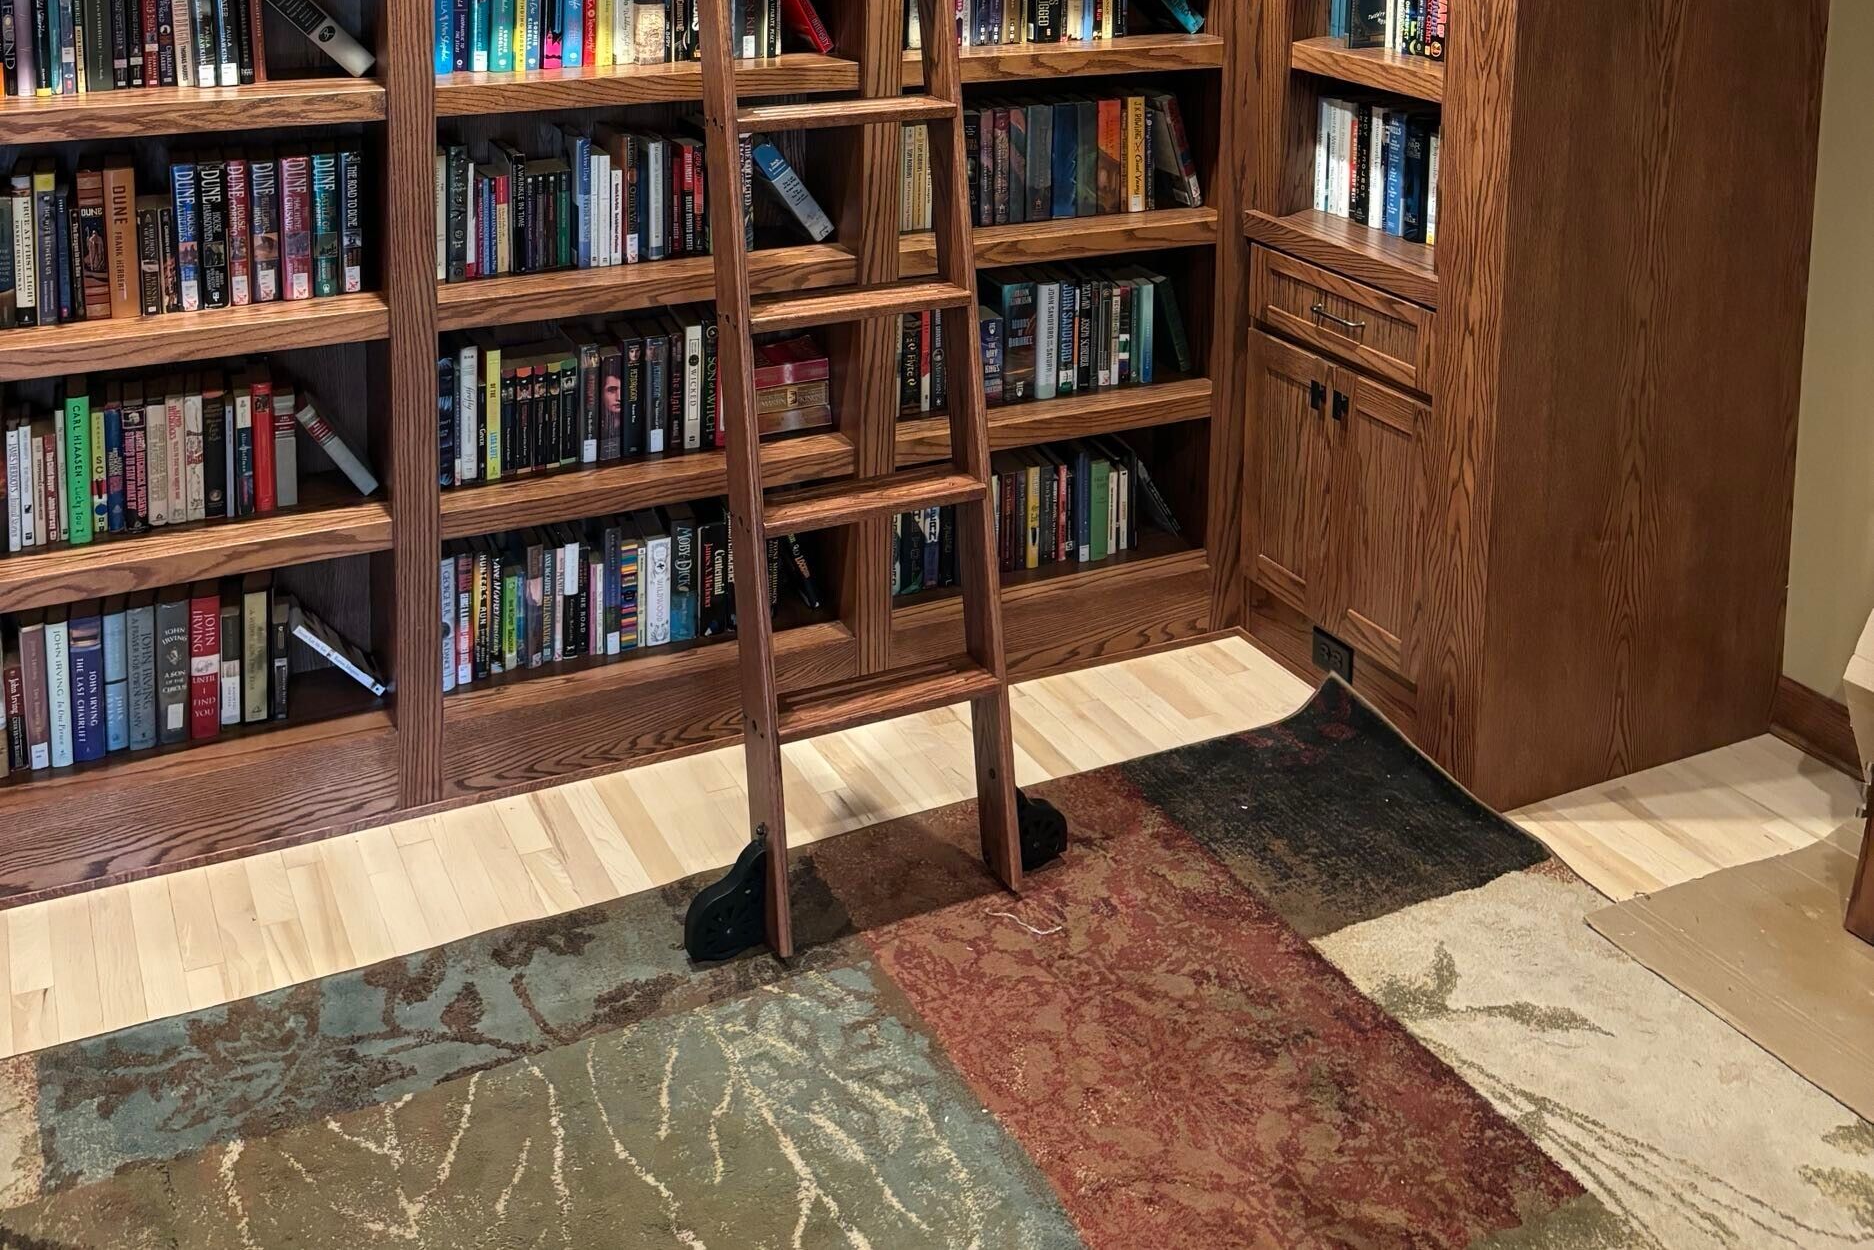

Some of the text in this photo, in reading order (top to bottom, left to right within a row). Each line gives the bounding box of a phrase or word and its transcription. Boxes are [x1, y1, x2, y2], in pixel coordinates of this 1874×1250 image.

[1437, 24, 1444, 38] OF
[220, 32, 228, 64] HAWKINS
[176, 170, 195, 207] DUNE
[201, 170, 221, 203] DUNE
[227, 166, 244, 199] DUNE
[252, 163, 273, 196] DUNE
[284, 160, 306, 195] DUNE
[313, 158, 335, 192] DUNE
[347, 165, 358, 227] THE ROAD TO DUNE
[518, 202, 524, 210] IN
[178, 206, 187, 242] ATREIDES
[186, 211, 195, 236] HOUSE
[203, 204, 213, 242] HARKONNEN
[213, 212, 221, 233] HOUSE
[237, 204, 246, 231] HOUSE
[685, 214, 693, 233] DEVOTED
[24, 229, 31, 241] AT
[26, 275, 34, 304] LIGHT
[1061, 284, 1074, 362] JOHN SANDFORD
[905, 354, 918, 377] Flyte
[461, 386, 475, 410] firefly
[670, 391, 681, 415] light
[72, 405, 85, 525] CARL HIAASEN Lucky You
[674, 527, 692, 587] MOBY-DICK
[714, 550, 724, 594] Centennial
[656, 580, 664, 622] WILDWOOD
[192, 610, 206, 652] IRVING
[204, 613, 215, 646] JOHN
[140, 633, 153, 709] JOHN IRVING
[8, 678, 20, 714] John Irving
[88, 670, 98, 726] JOHN IRVING
[115, 696, 124, 720] JOHN
